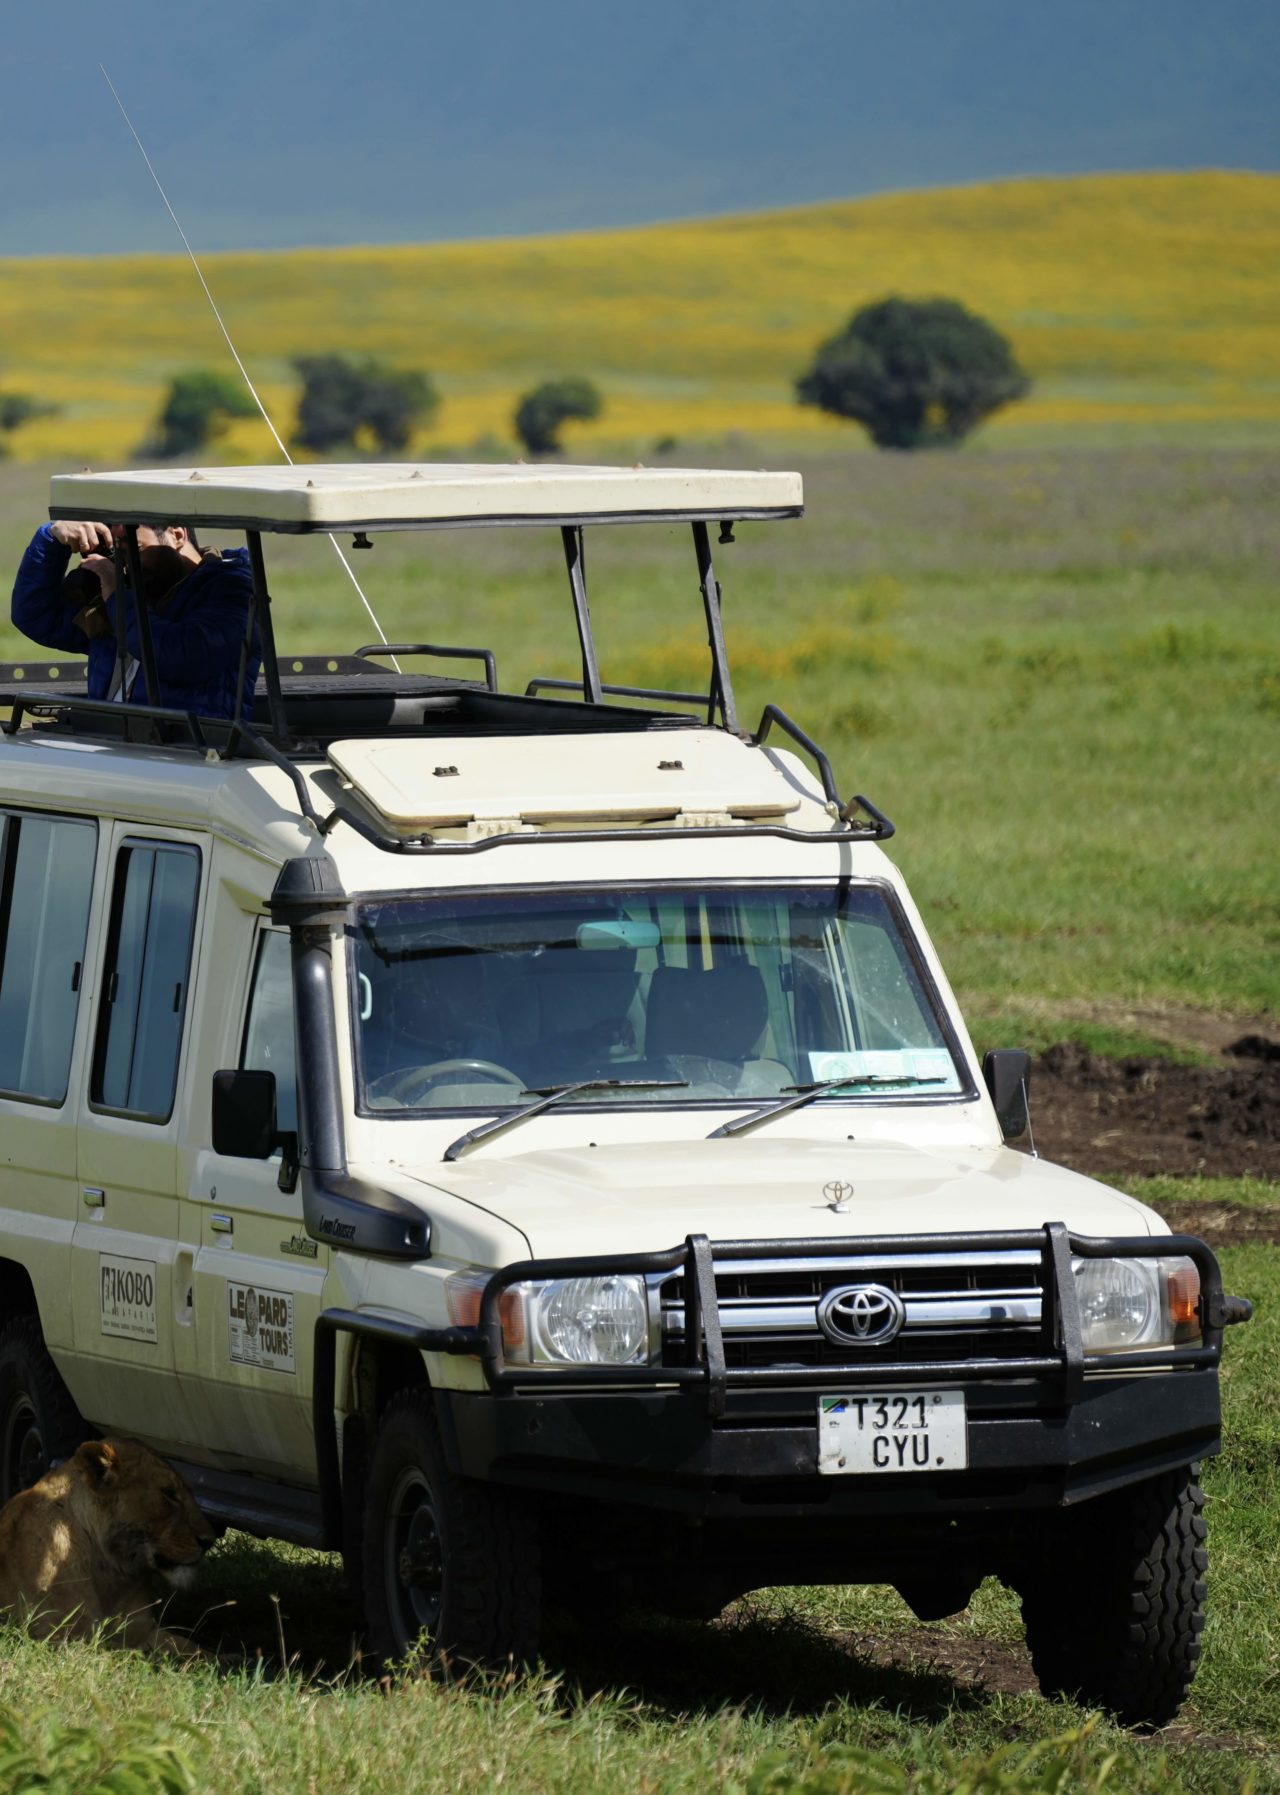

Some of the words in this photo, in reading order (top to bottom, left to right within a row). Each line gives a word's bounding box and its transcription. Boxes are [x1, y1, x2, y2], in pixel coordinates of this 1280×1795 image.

[117, 1269, 154, 1308] KOBO
[259, 1327, 289, 1356] TOURS
[852, 1396, 929, 1430] T321
[873, 1434, 930, 1468] CYU
